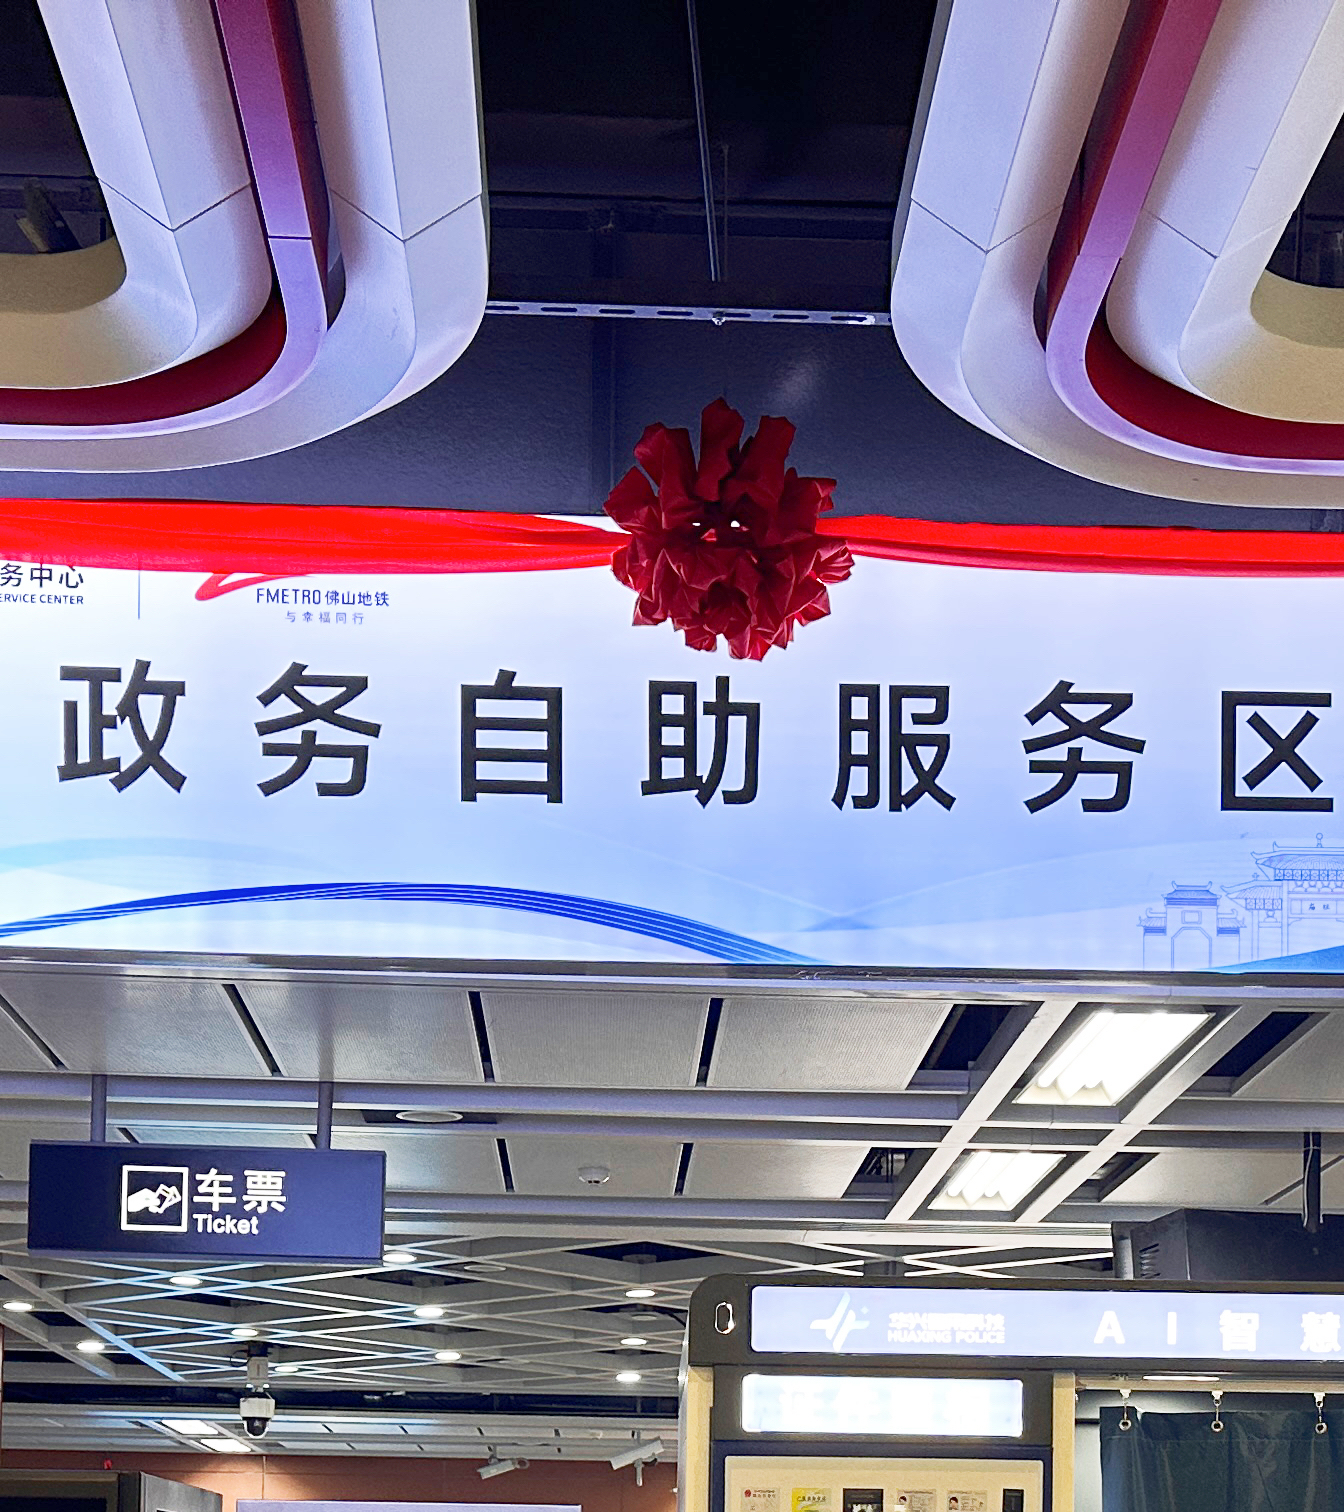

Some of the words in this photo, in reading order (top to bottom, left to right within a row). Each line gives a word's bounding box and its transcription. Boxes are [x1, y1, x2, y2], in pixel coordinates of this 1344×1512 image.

[39, 594, 84, 605] CENTER
[256, 587, 322, 605] FMETRO
[324, 590, 390, 606] 佛山地铁
[57, 659, 1334, 814] 政务自助服务区
[192, 1167, 287, 1213] 车票
[192, 1213, 259, 1235] Ticket
[887, 1329, 953, 1343] HUAXING
[955, 1331, 1006, 1345] POLICE
